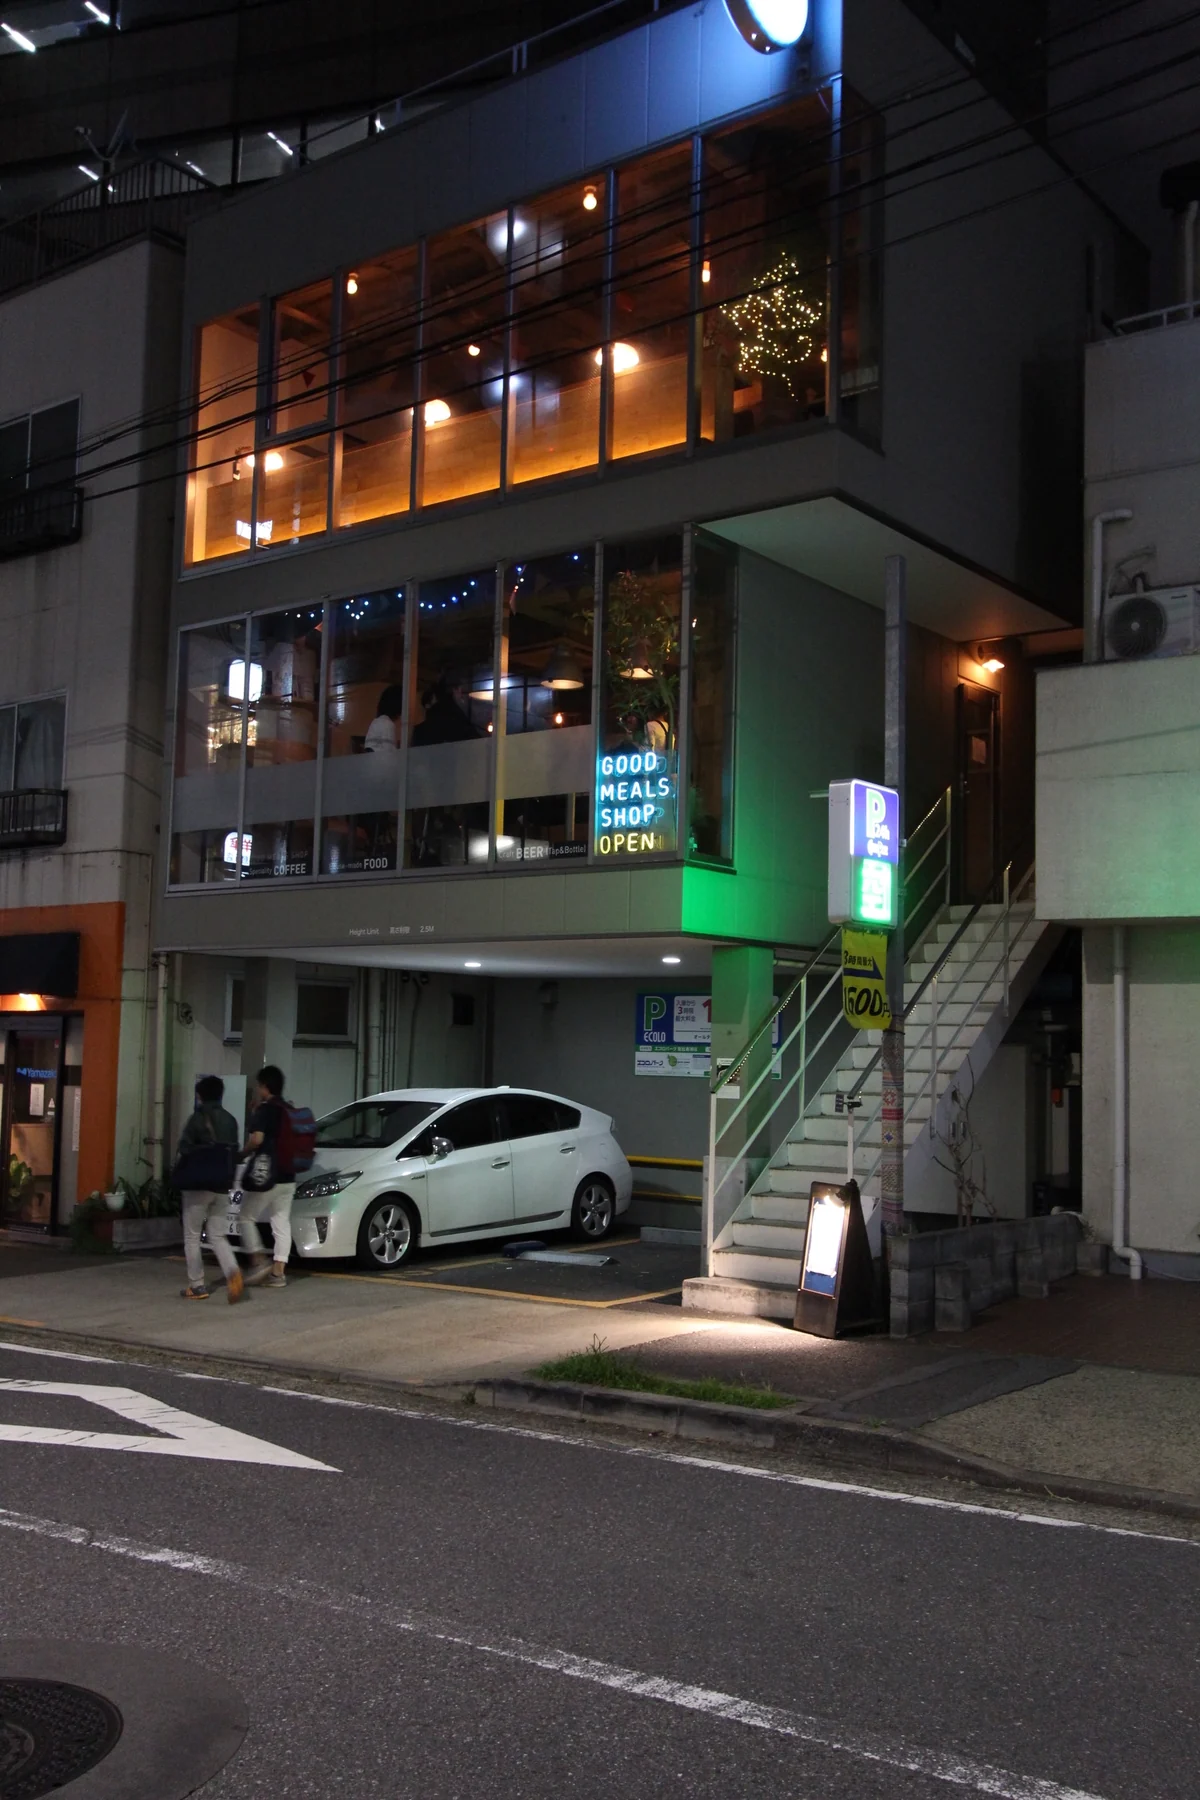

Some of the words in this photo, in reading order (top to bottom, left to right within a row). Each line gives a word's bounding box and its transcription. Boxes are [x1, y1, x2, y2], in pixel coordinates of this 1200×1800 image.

[601, 752, 657, 775] GOOD
[600, 777, 670, 801] MEALS
[601, 804, 655, 827] SHOP
[866, 787, 885, 839] P
[516, 846, 544, 859] BEER
[600, 832, 654, 854] OPEN
[273, 863, 306, 876] COFFEE
[363, 857, 388, 870] FOOD
[349, 927, 366, 936] Height
[644, 996, 667, 1031] P
[644, 1032, 666, 1042] ECOLO
